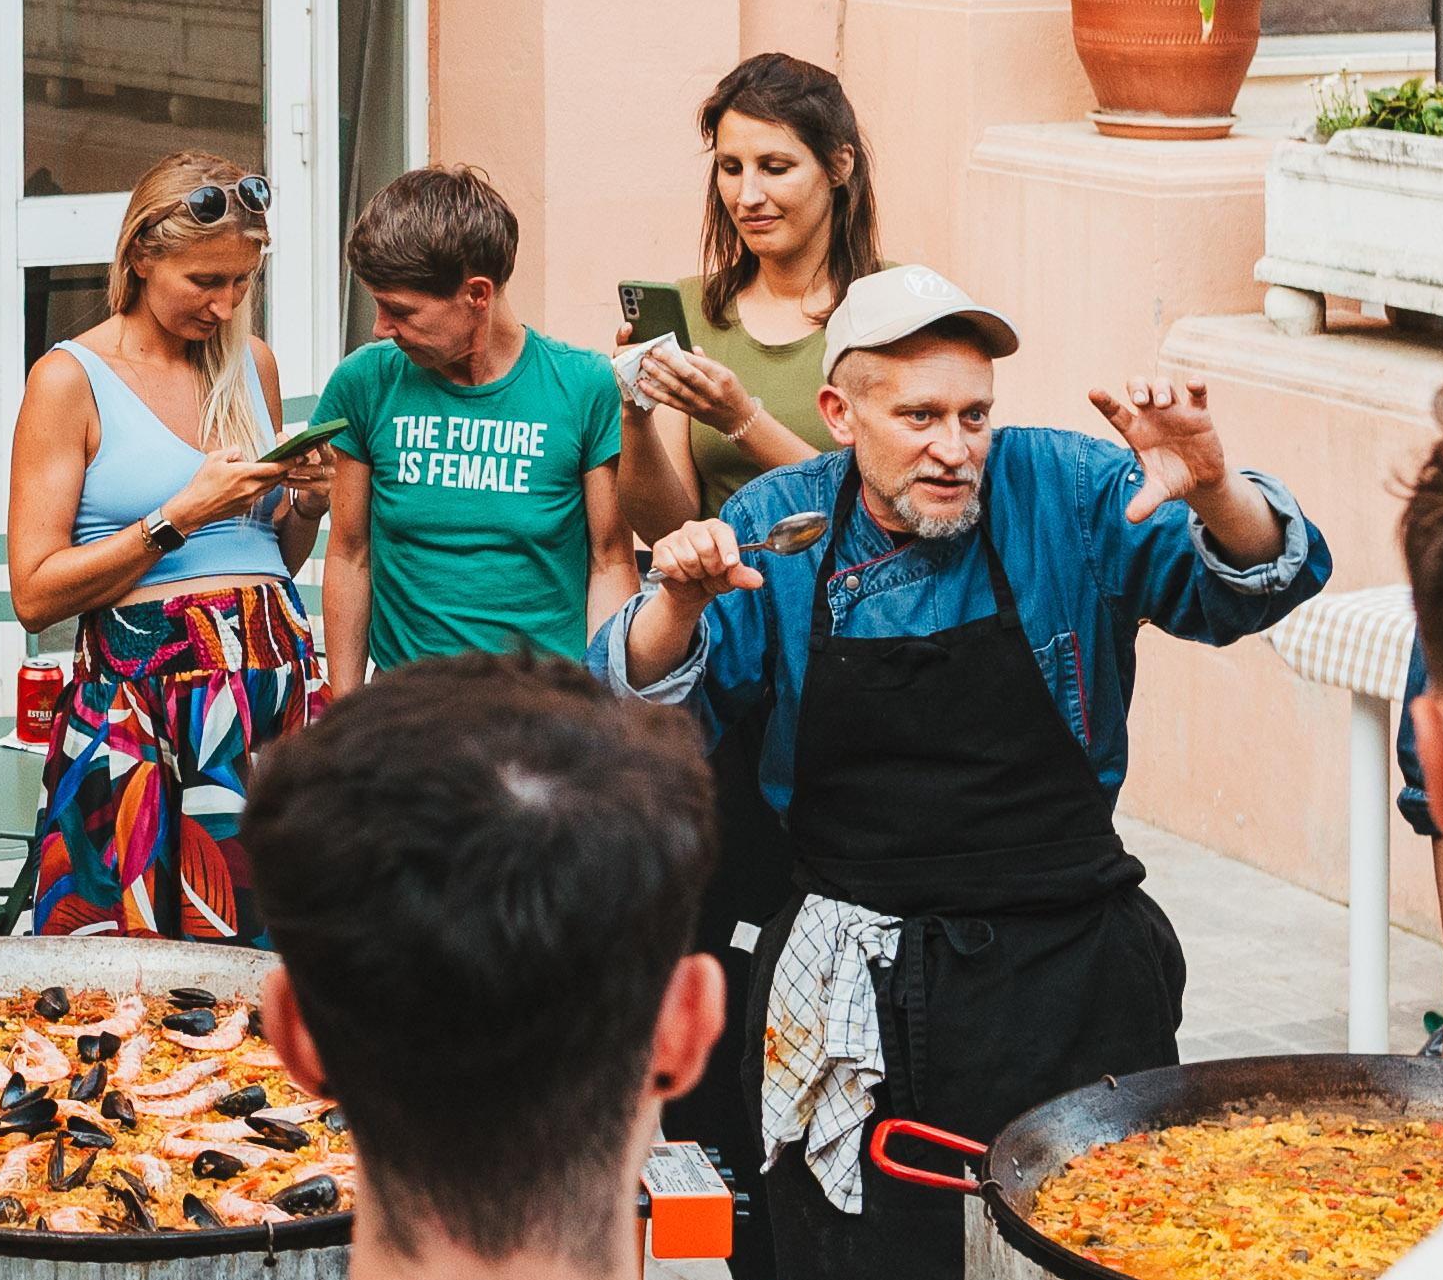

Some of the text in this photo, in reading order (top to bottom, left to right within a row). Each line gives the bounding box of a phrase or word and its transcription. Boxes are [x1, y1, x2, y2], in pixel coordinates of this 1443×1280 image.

[393, 415, 548, 457] THE FUTURE
[397, 451, 532, 493] IS FEMALE
